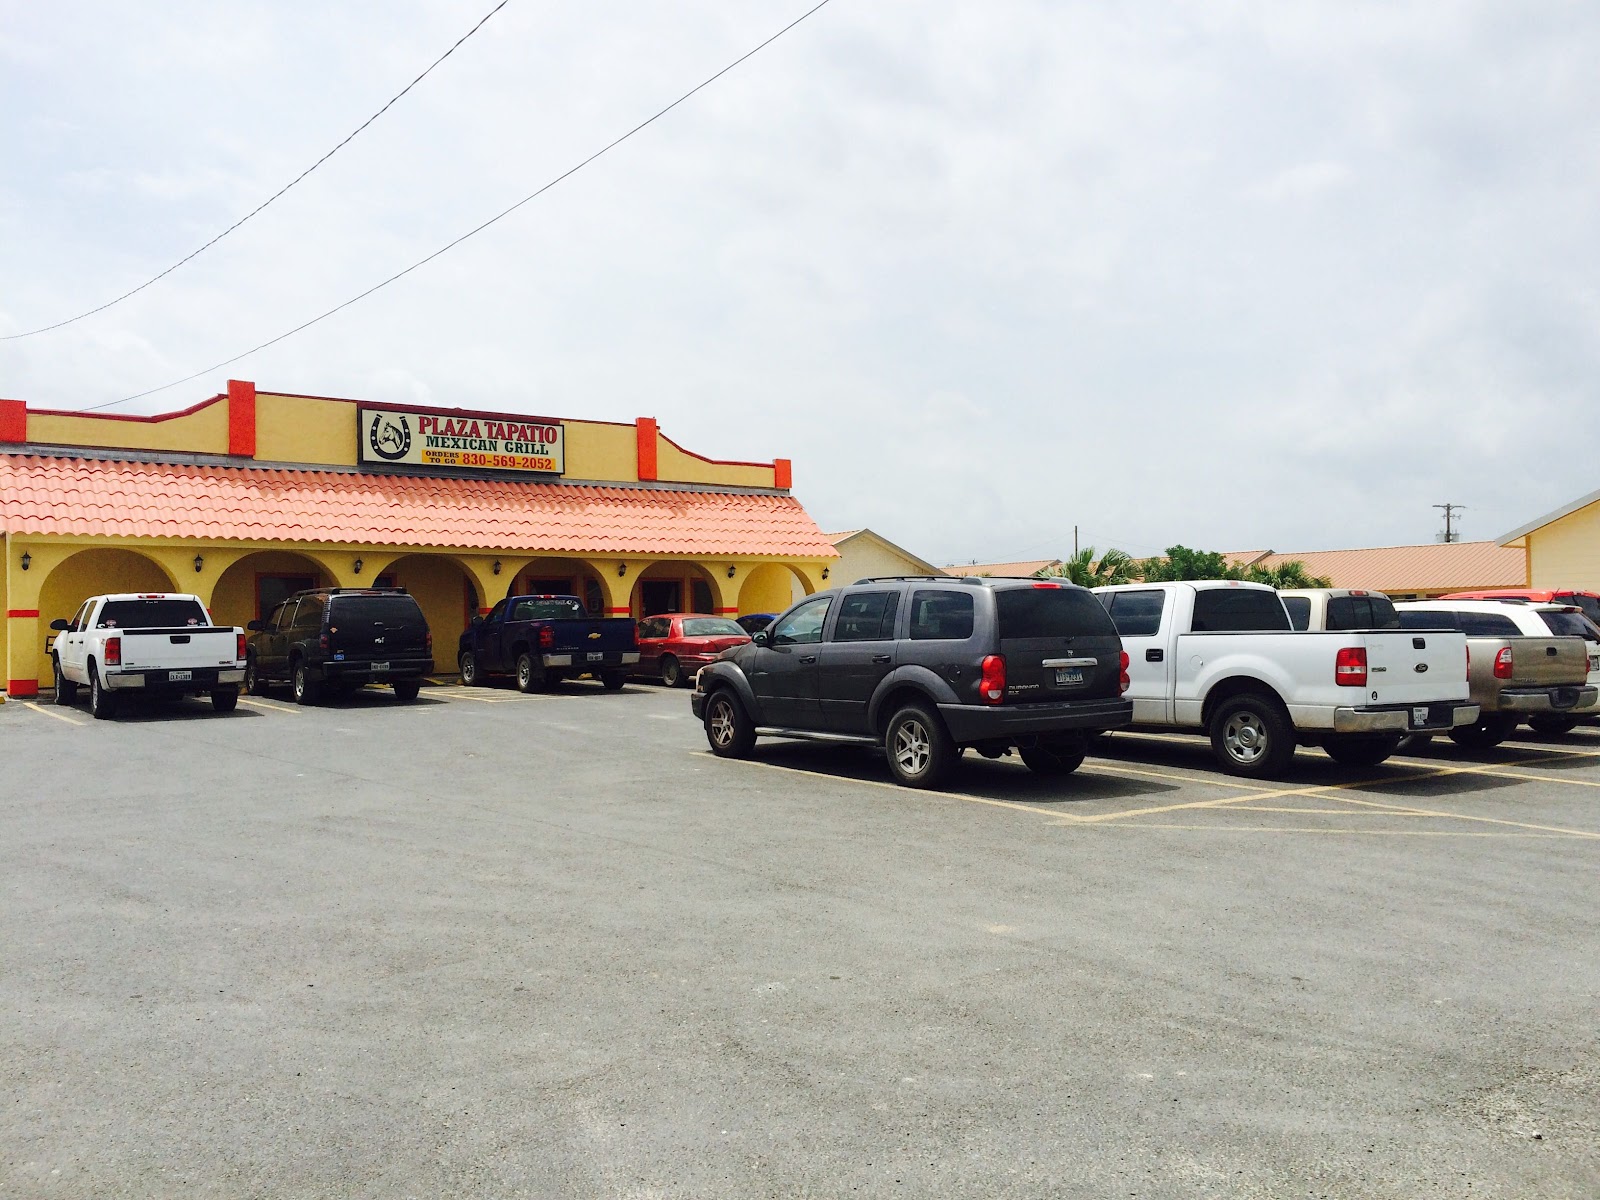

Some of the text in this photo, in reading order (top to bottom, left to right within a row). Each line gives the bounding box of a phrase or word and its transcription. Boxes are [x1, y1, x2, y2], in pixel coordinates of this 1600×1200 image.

[419, 416, 557, 444] PLAZA TAPATIO
[426, 436, 548, 455] MEXICAN GRILL
[463, 453, 551, 470] 830-569-2052
